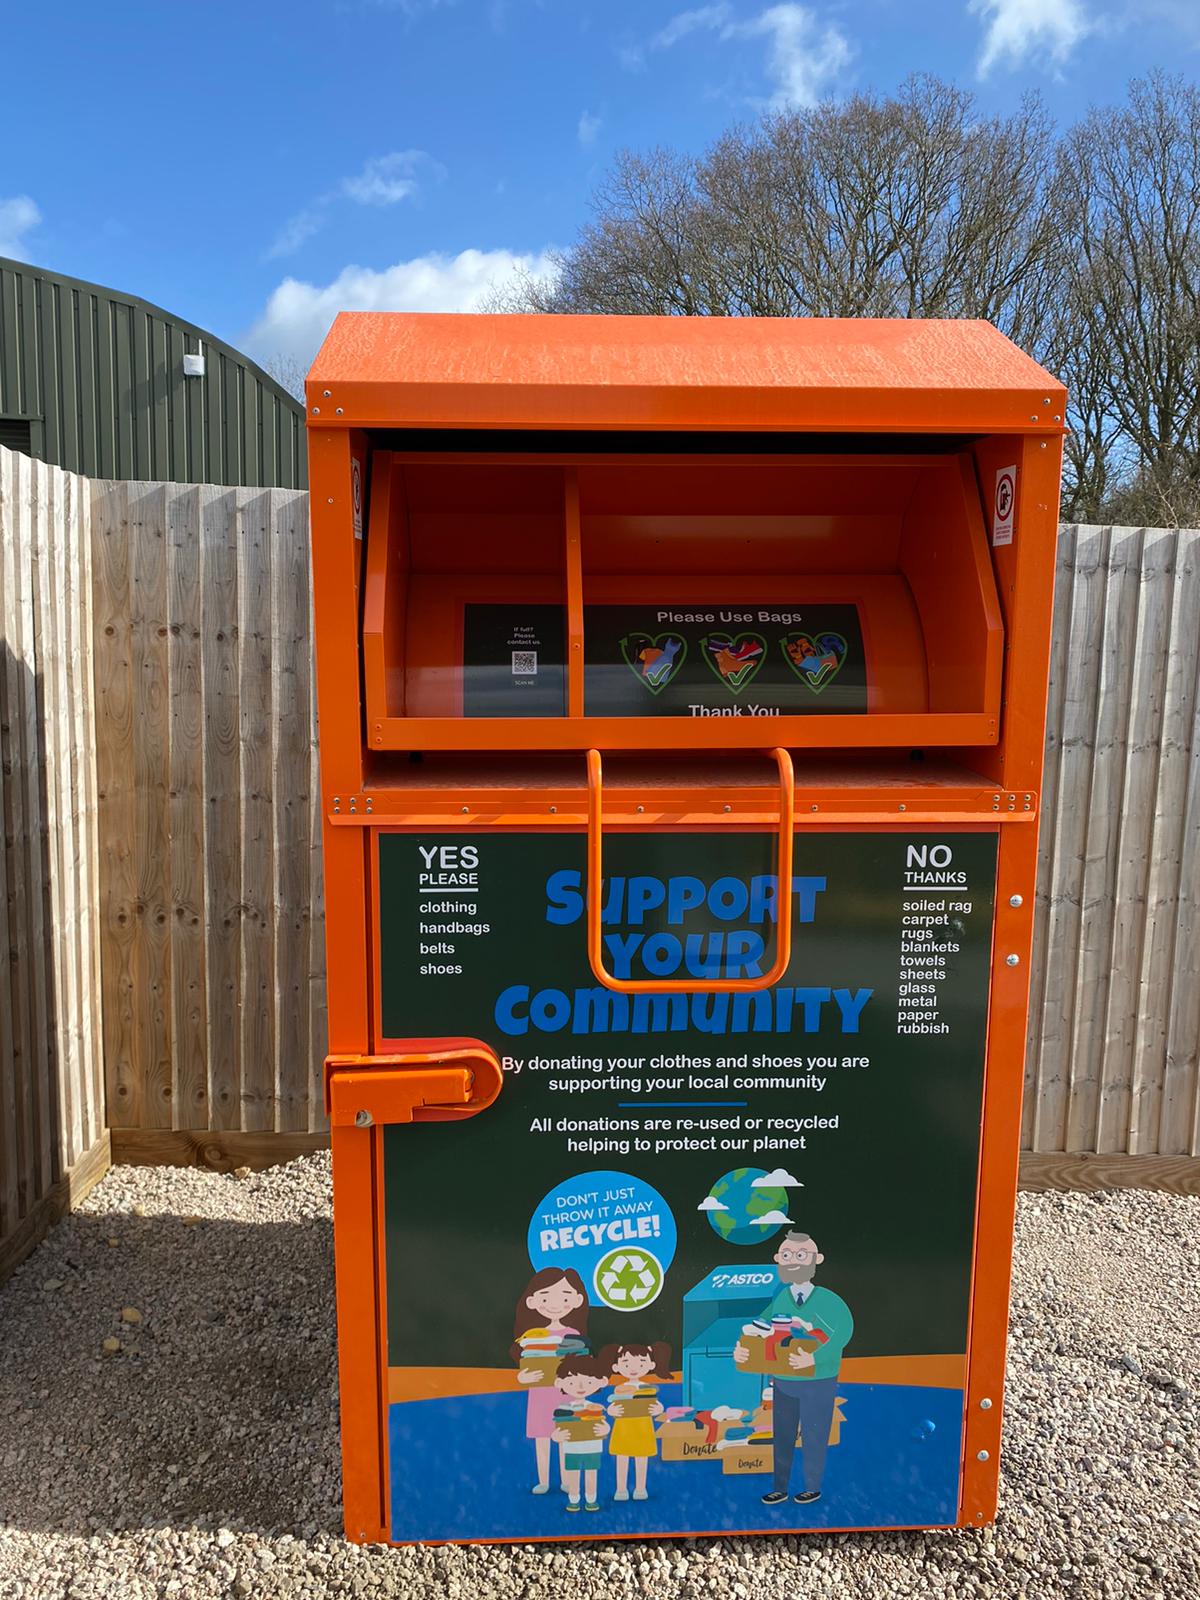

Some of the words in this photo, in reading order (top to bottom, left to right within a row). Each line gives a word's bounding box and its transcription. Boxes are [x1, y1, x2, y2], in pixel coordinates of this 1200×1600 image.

[657, 611, 715, 623] Please
[719, 611, 753, 623] Use
[757, 611, 802, 625] Bags
[688, 704, 742, 717] Thank
[747, 704, 780, 717] You
[418, 845, 479, 870] YES
[906, 844, 953, 868] NO
[419, 872, 479, 885] PLEASE
[903, 871, 967, 884] THANKS
[419, 901, 477, 915] clothing
[902, 899, 945, 911] soiled
[948, 902, 973, 915] rag
[902, 913, 949, 928] carpet
[419, 921, 490, 936] handbags
[901, 929, 934, 941] rugs
[420, 942, 455, 955] belts
[901, 940, 960, 953] blankets
[900, 954, 946, 967] towels
[420, 962, 463, 975] shoes
[899, 968, 946, 980] sheets
[899, 981, 936, 995] glass
[898, 995, 937, 1007] metal
[898, 1009, 939, 1023] paper
[897, 1022, 950, 1034] rubbish
[502, 1056, 524, 1073] By
[528, 1055, 603, 1072] donating
[606, 1057, 646, 1072] your
[649, 1054, 712, 1069] clothes
[715, 1054, 748, 1068] and
[751, 1054, 803, 1068] shoes
[806, 1057, 837, 1071] you
[841, 1057, 870, 1068] are
[548, 1075, 642, 1093] supporting
[645, 1078, 685, 1092] your
[688, 1074, 729, 1089] local
[733, 1074, 827, 1092] community
[529, 1117, 552, 1132] All
[556, 1117, 640, 1132] donations
[643, 1119, 672, 1131] are
[676, 1115, 740, 1130] re-used
[744, 1118, 764, 1130] or
[767, 1114, 839, 1133] recycled
[567, 1137, 630, 1155] helping
[633, 1137, 651, 1151] to
[655, 1136, 717, 1154] protect
[720, 1139, 750, 1150] our
[753, 1135, 807, 1153] planet
[556, 1192, 599, 1208] DON'T
[603, 1187, 635, 1202] JUST
[542, 1208, 594, 1225] THROW
[598, 1206, 610, 1218] IT
[614, 1200, 653, 1216] AWAY
[540, 1214, 661, 1252] RECYCLE!
[728, 1273, 774, 1285] ASTCO
[683, 1442, 718, 1456] Donate
[738, 1458, 763, 1469] Donate
